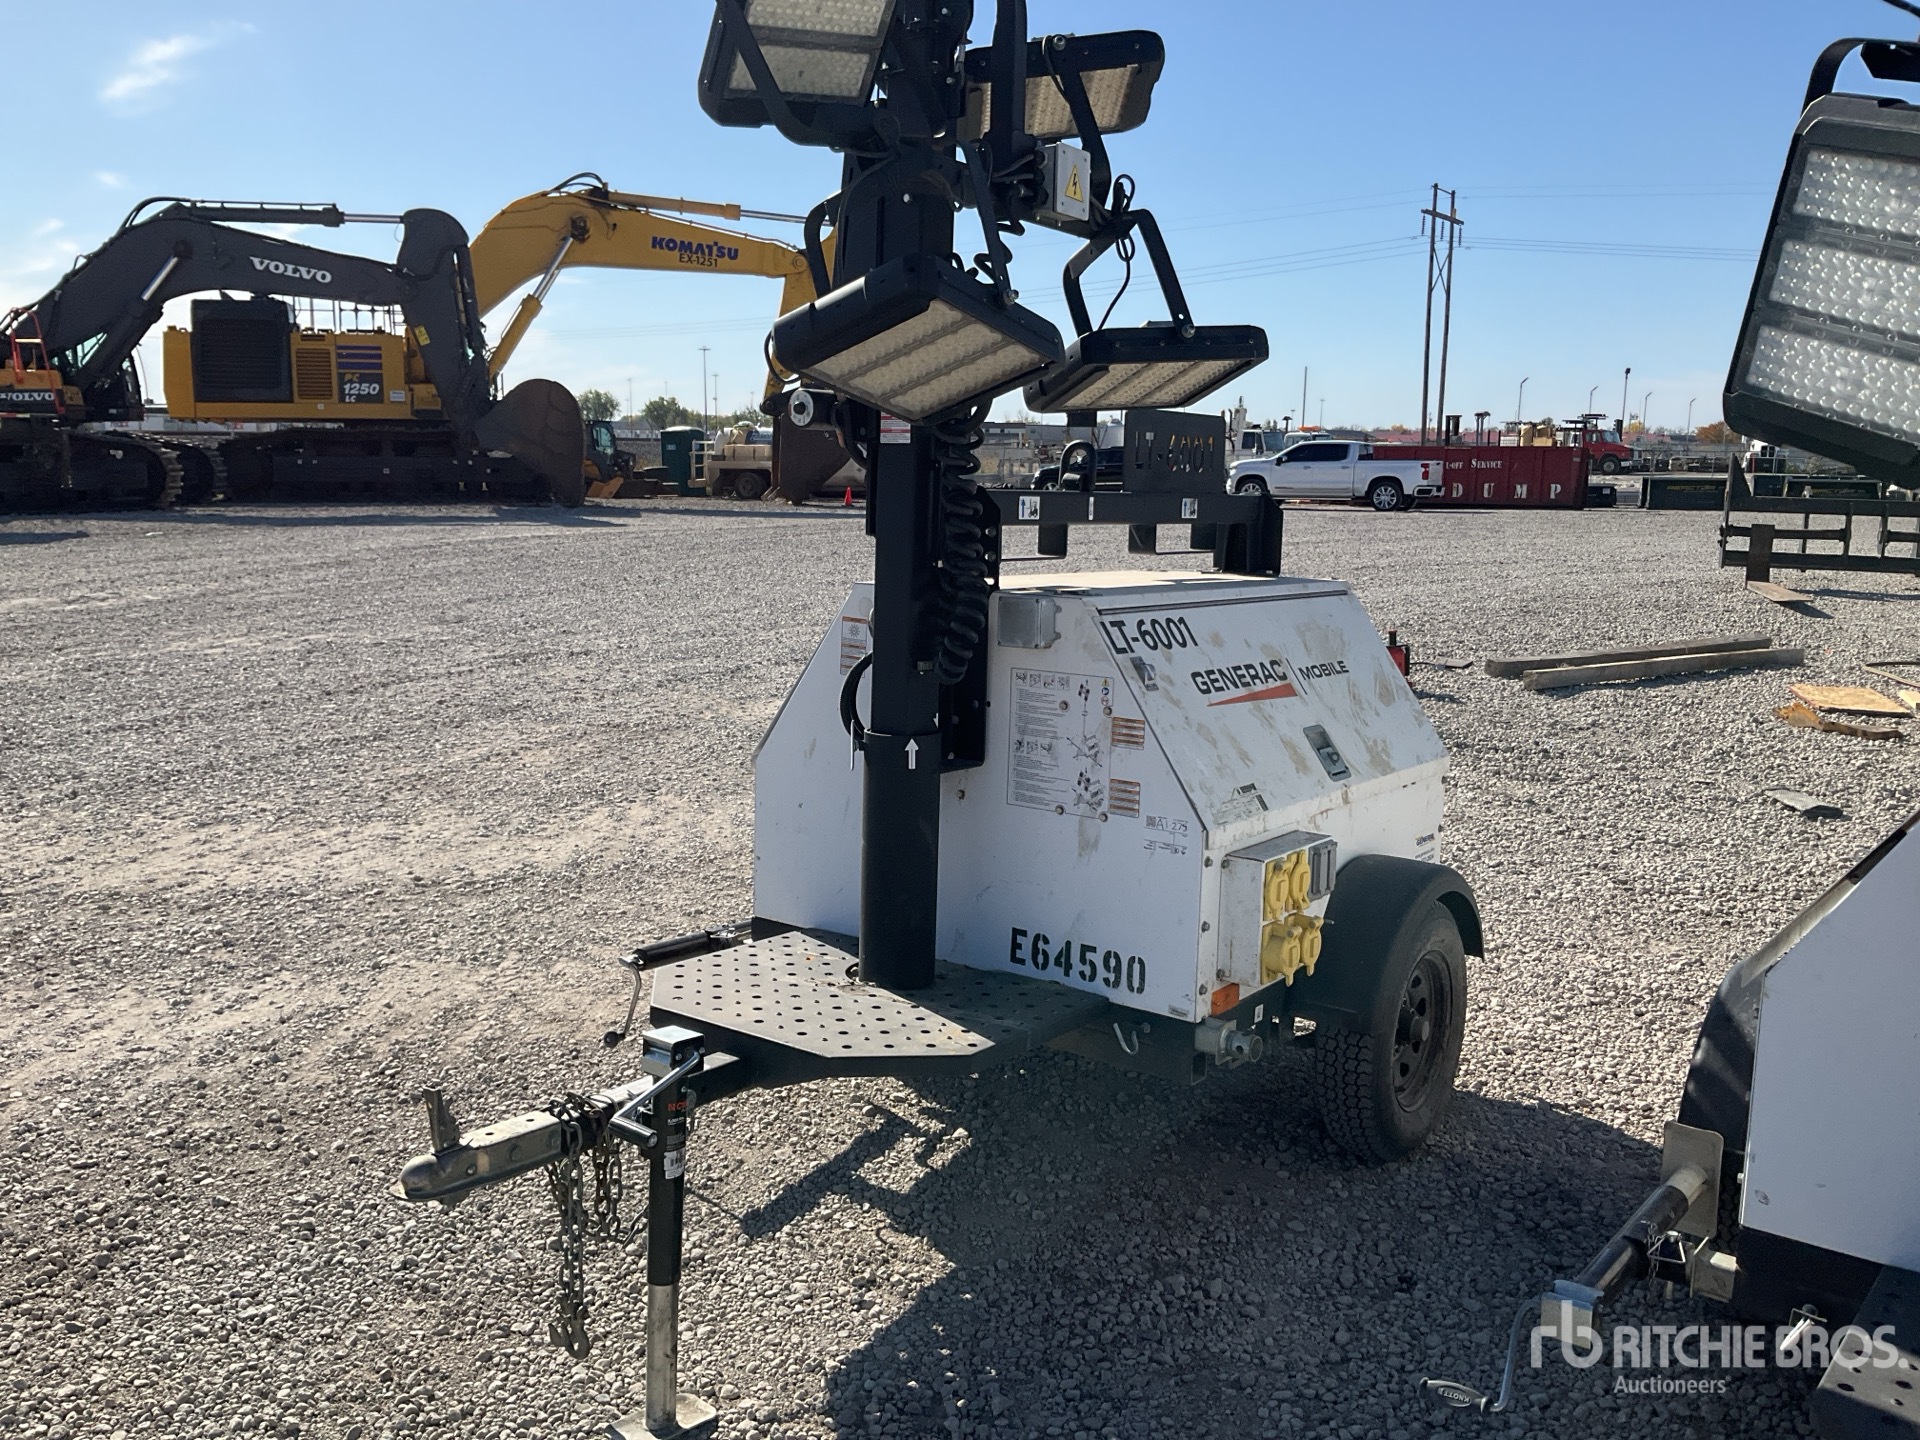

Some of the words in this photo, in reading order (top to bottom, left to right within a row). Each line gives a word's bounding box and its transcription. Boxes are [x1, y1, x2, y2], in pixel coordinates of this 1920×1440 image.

[651, 236, 739, 261] KOMATSU
[678, 253, 718, 268] EX-1251
[249, 256, 332, 283] VOLVO
[343, 383, 380, 395] 1250
[345, 395, 357, 403] LC
[1100, 616, 1199, 655] LT-6001
[1190, 659, 1288, 695] GENERAC
[1298, 660, 1350, 681] MOBILE
[1009, 926, 1146, 995] E64590
